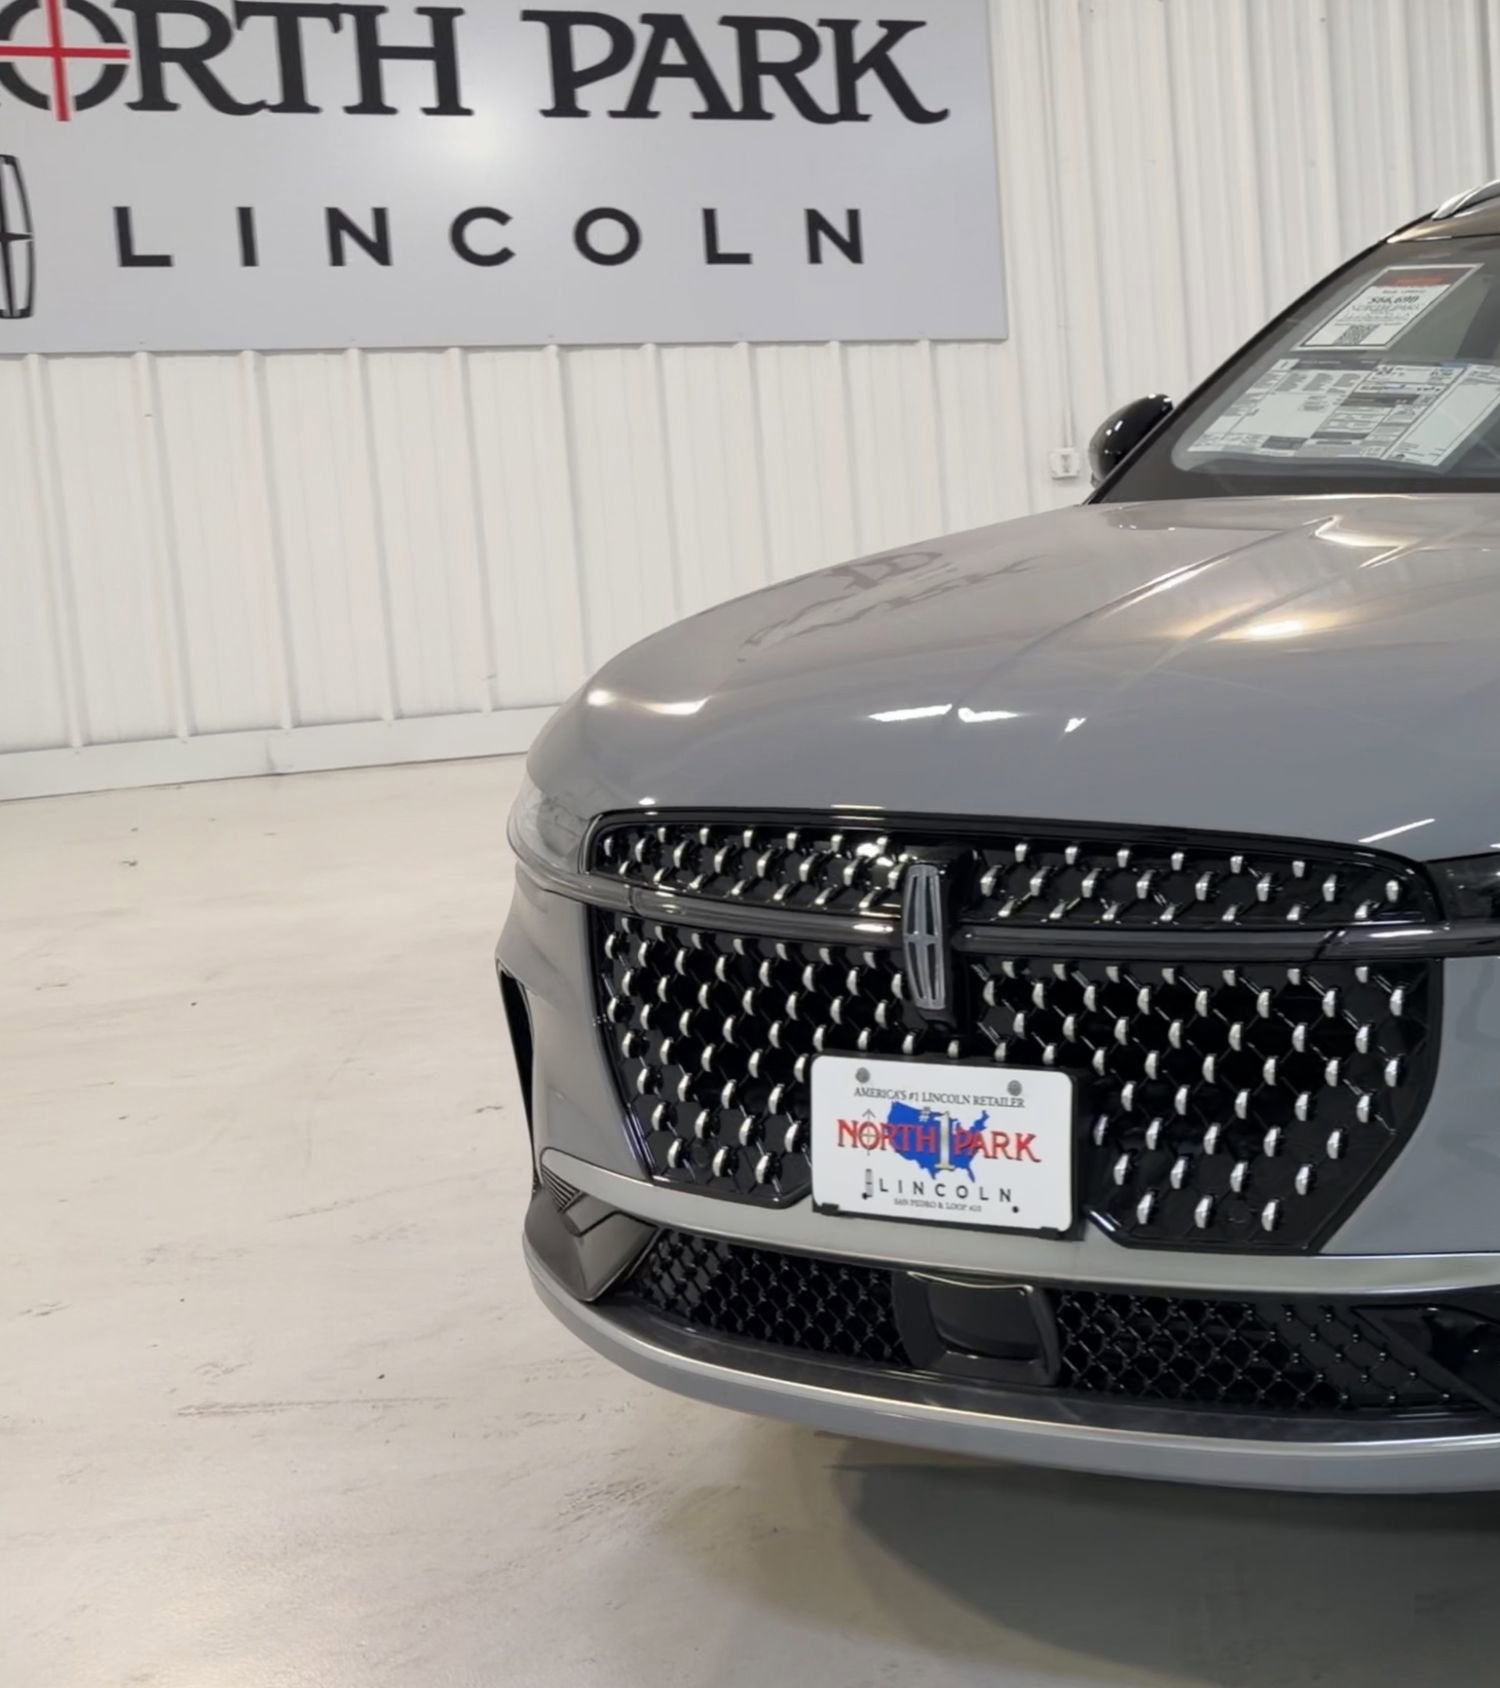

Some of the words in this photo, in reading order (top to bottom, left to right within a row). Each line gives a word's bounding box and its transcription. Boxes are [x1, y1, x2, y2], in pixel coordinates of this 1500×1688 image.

[0, 0, 474, 120] ORTH
[522, 9, 949, 125] PARK
[113, 206, 864, 268] LINCOLN
[854, 1087, 907, 1100] AMERICA'S
[908, 1092, 919, 1101] #1
[922, 1092, 971, 1105] LINCOLN
[972, 1095, 1026, 1108] RETAILER
[836, 1119, 937, 1153] NORTH
[954, 1128, 1042, 1163] PARK
[878, 1178, 1012, 1203] LINCOLN
